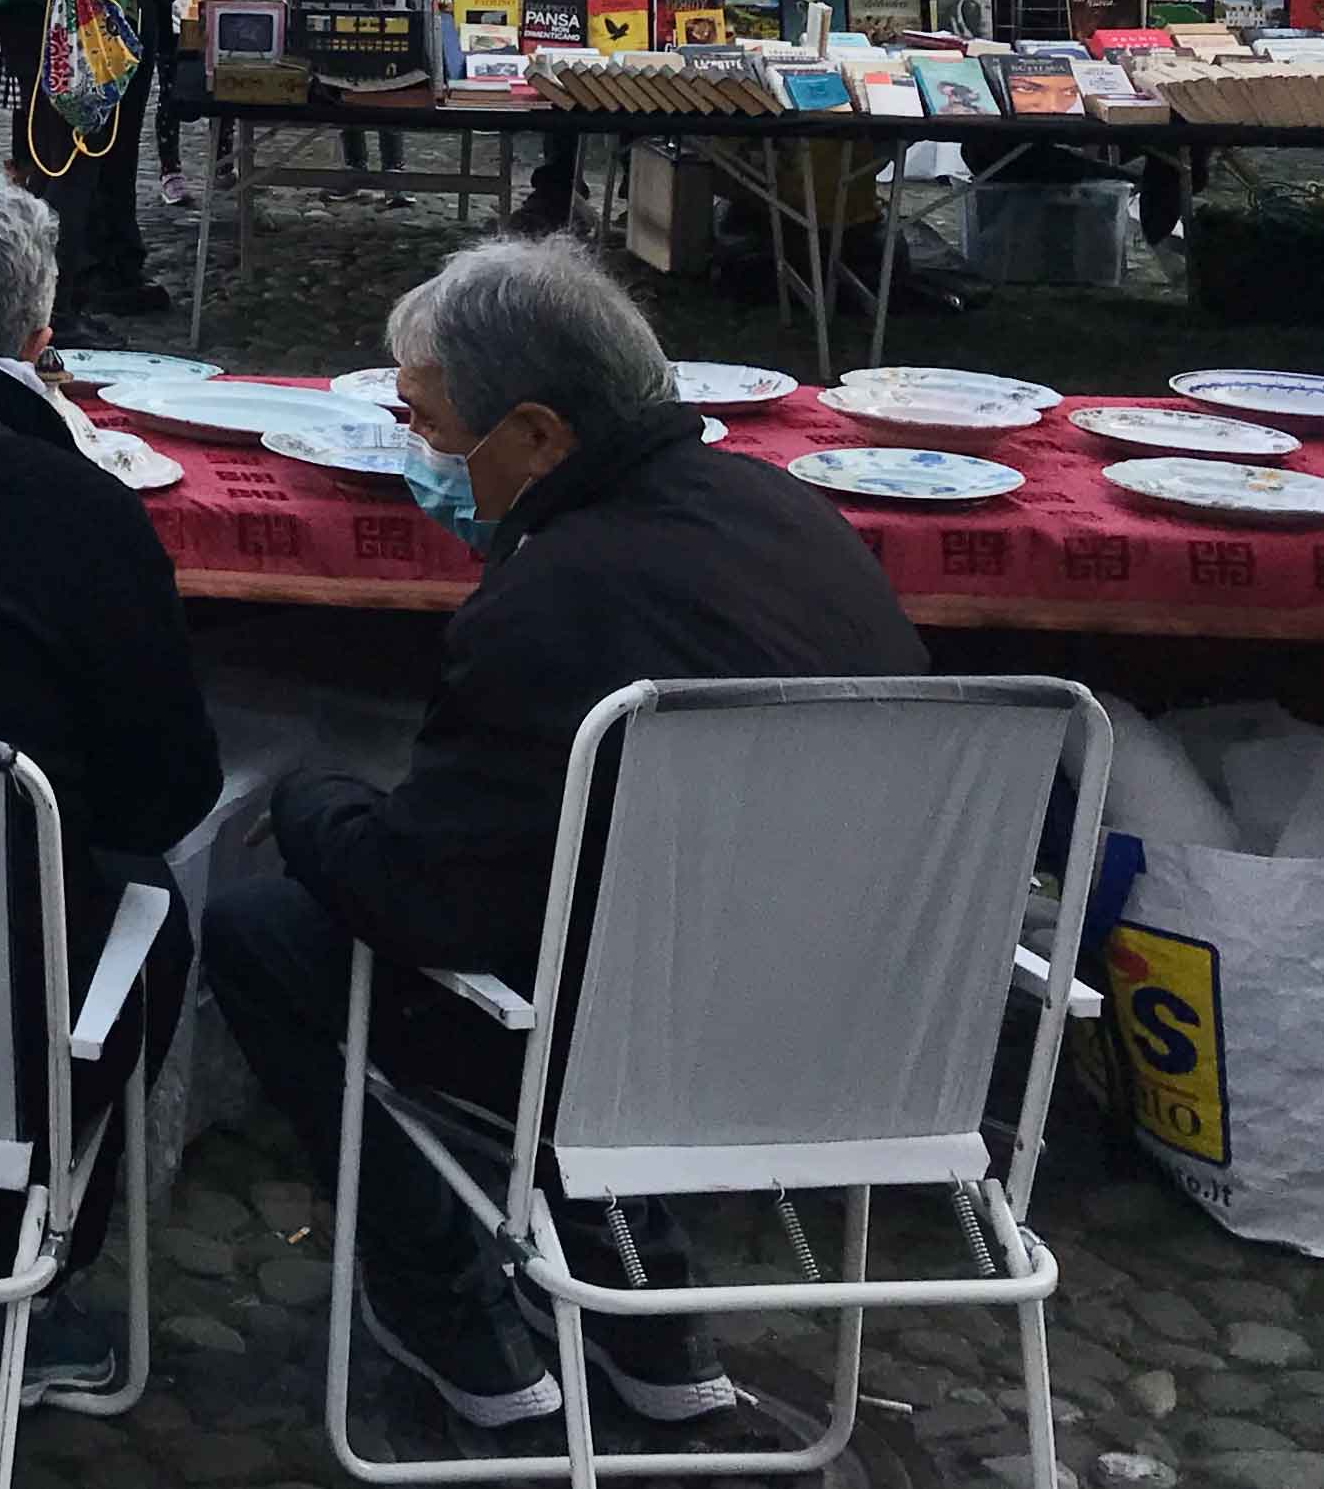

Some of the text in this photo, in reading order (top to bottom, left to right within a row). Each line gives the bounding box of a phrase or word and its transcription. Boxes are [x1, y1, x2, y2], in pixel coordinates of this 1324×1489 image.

[525, 11, 581, 29] PANSA
[523, 29, 581, 42] DIMENTICANO
[551, 25, 570, 34] NON
